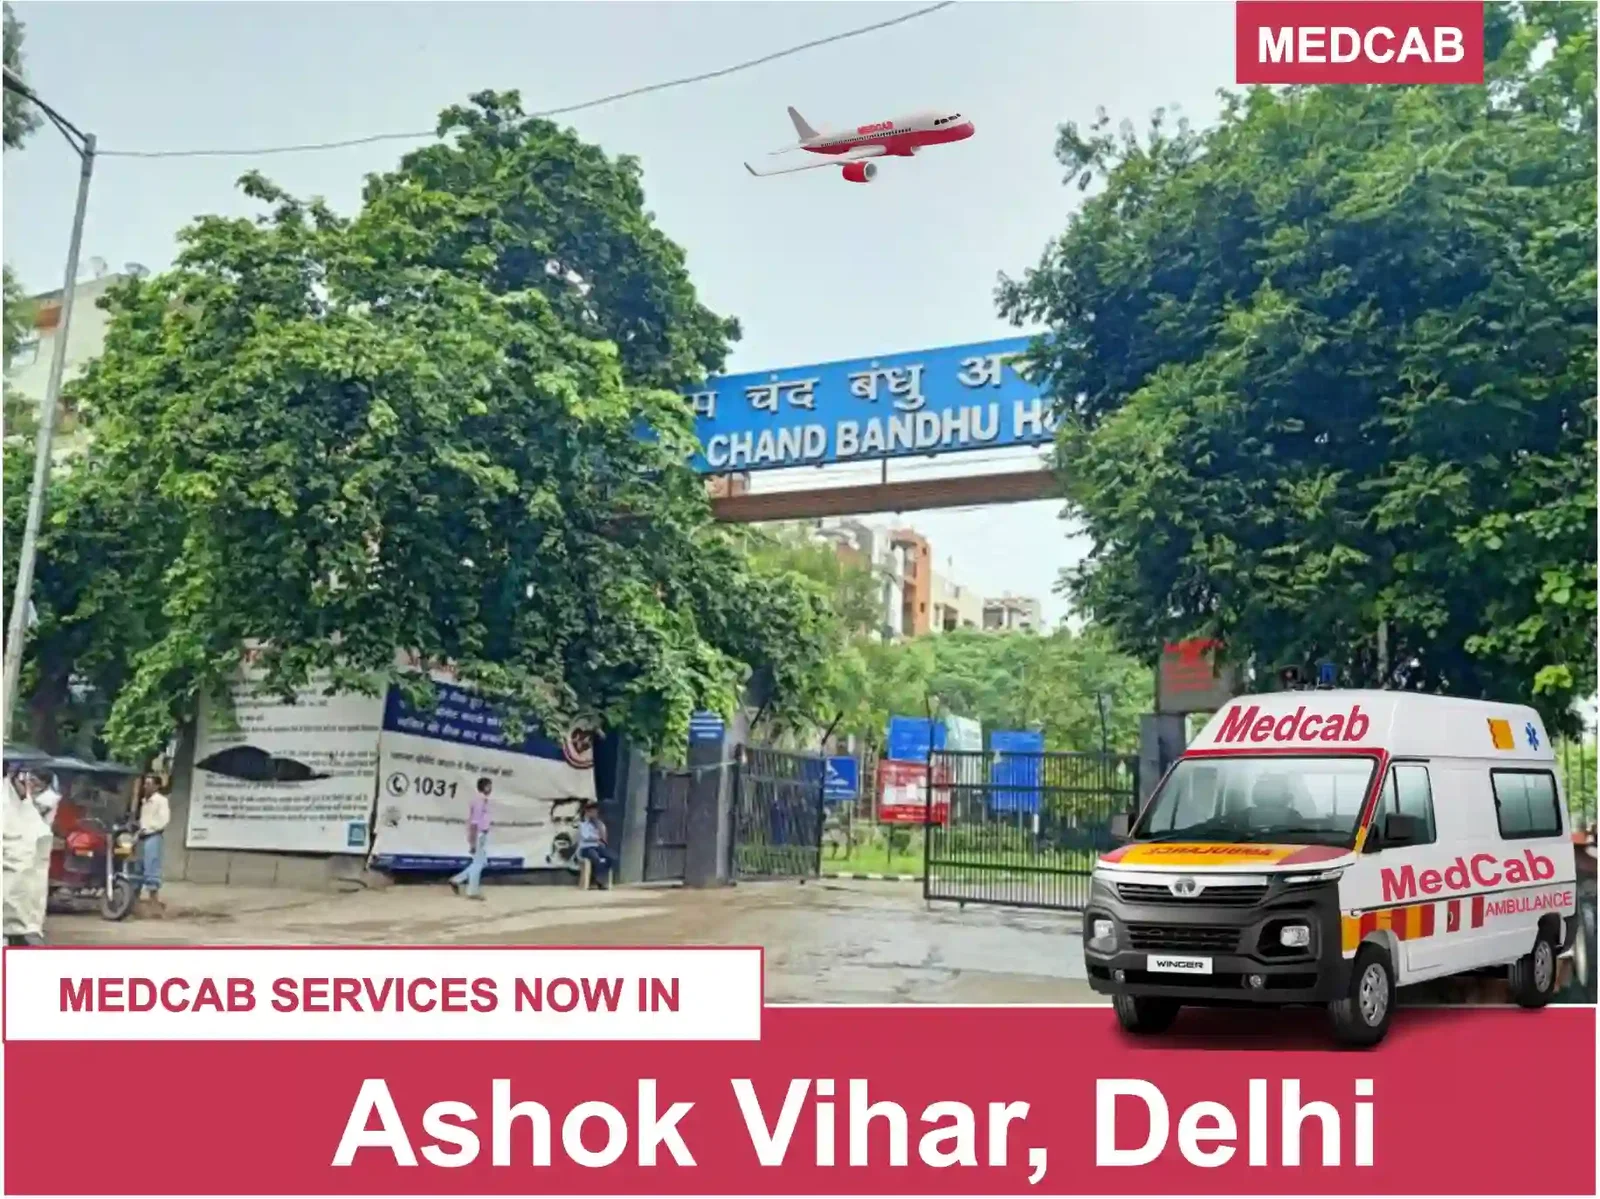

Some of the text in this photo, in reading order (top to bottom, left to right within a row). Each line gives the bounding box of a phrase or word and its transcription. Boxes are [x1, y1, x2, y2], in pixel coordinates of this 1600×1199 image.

[746, 374, 820, 413] चंद
[848, 360, 924, 411] बंधु
[707, 424, 826, 466] CHAND
[836, 402, 999, 457] BANDHU
[1214, 705, 1370, 743] Medcab
[414, 775, 458, 799] 1031
[1380, 849, 1555, 902] MedCab
[1485, 890, 1574, 917] AMBULANCE
[1156, 960, 1204, 969] WINGER
